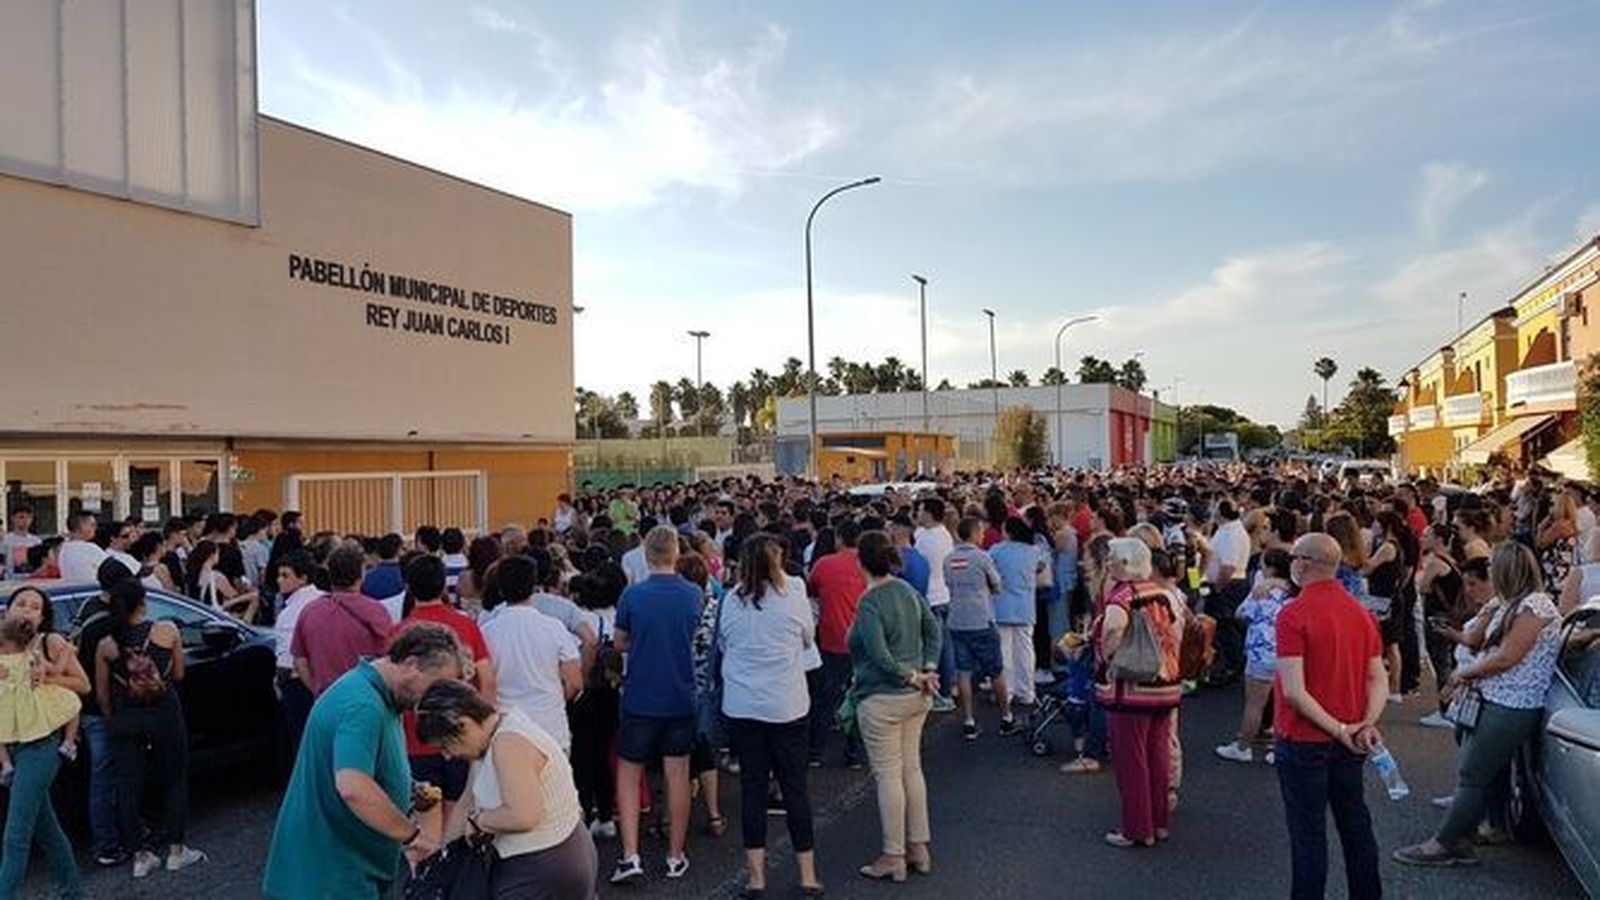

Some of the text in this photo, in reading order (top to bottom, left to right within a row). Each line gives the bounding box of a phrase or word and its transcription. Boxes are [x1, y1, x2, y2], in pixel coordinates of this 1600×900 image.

[289, 255, 557, 325] PABELLÓN MUNICIPAL DE DEPORTES
[366, 303, 511, 345] REY JUAN CARLOS I
